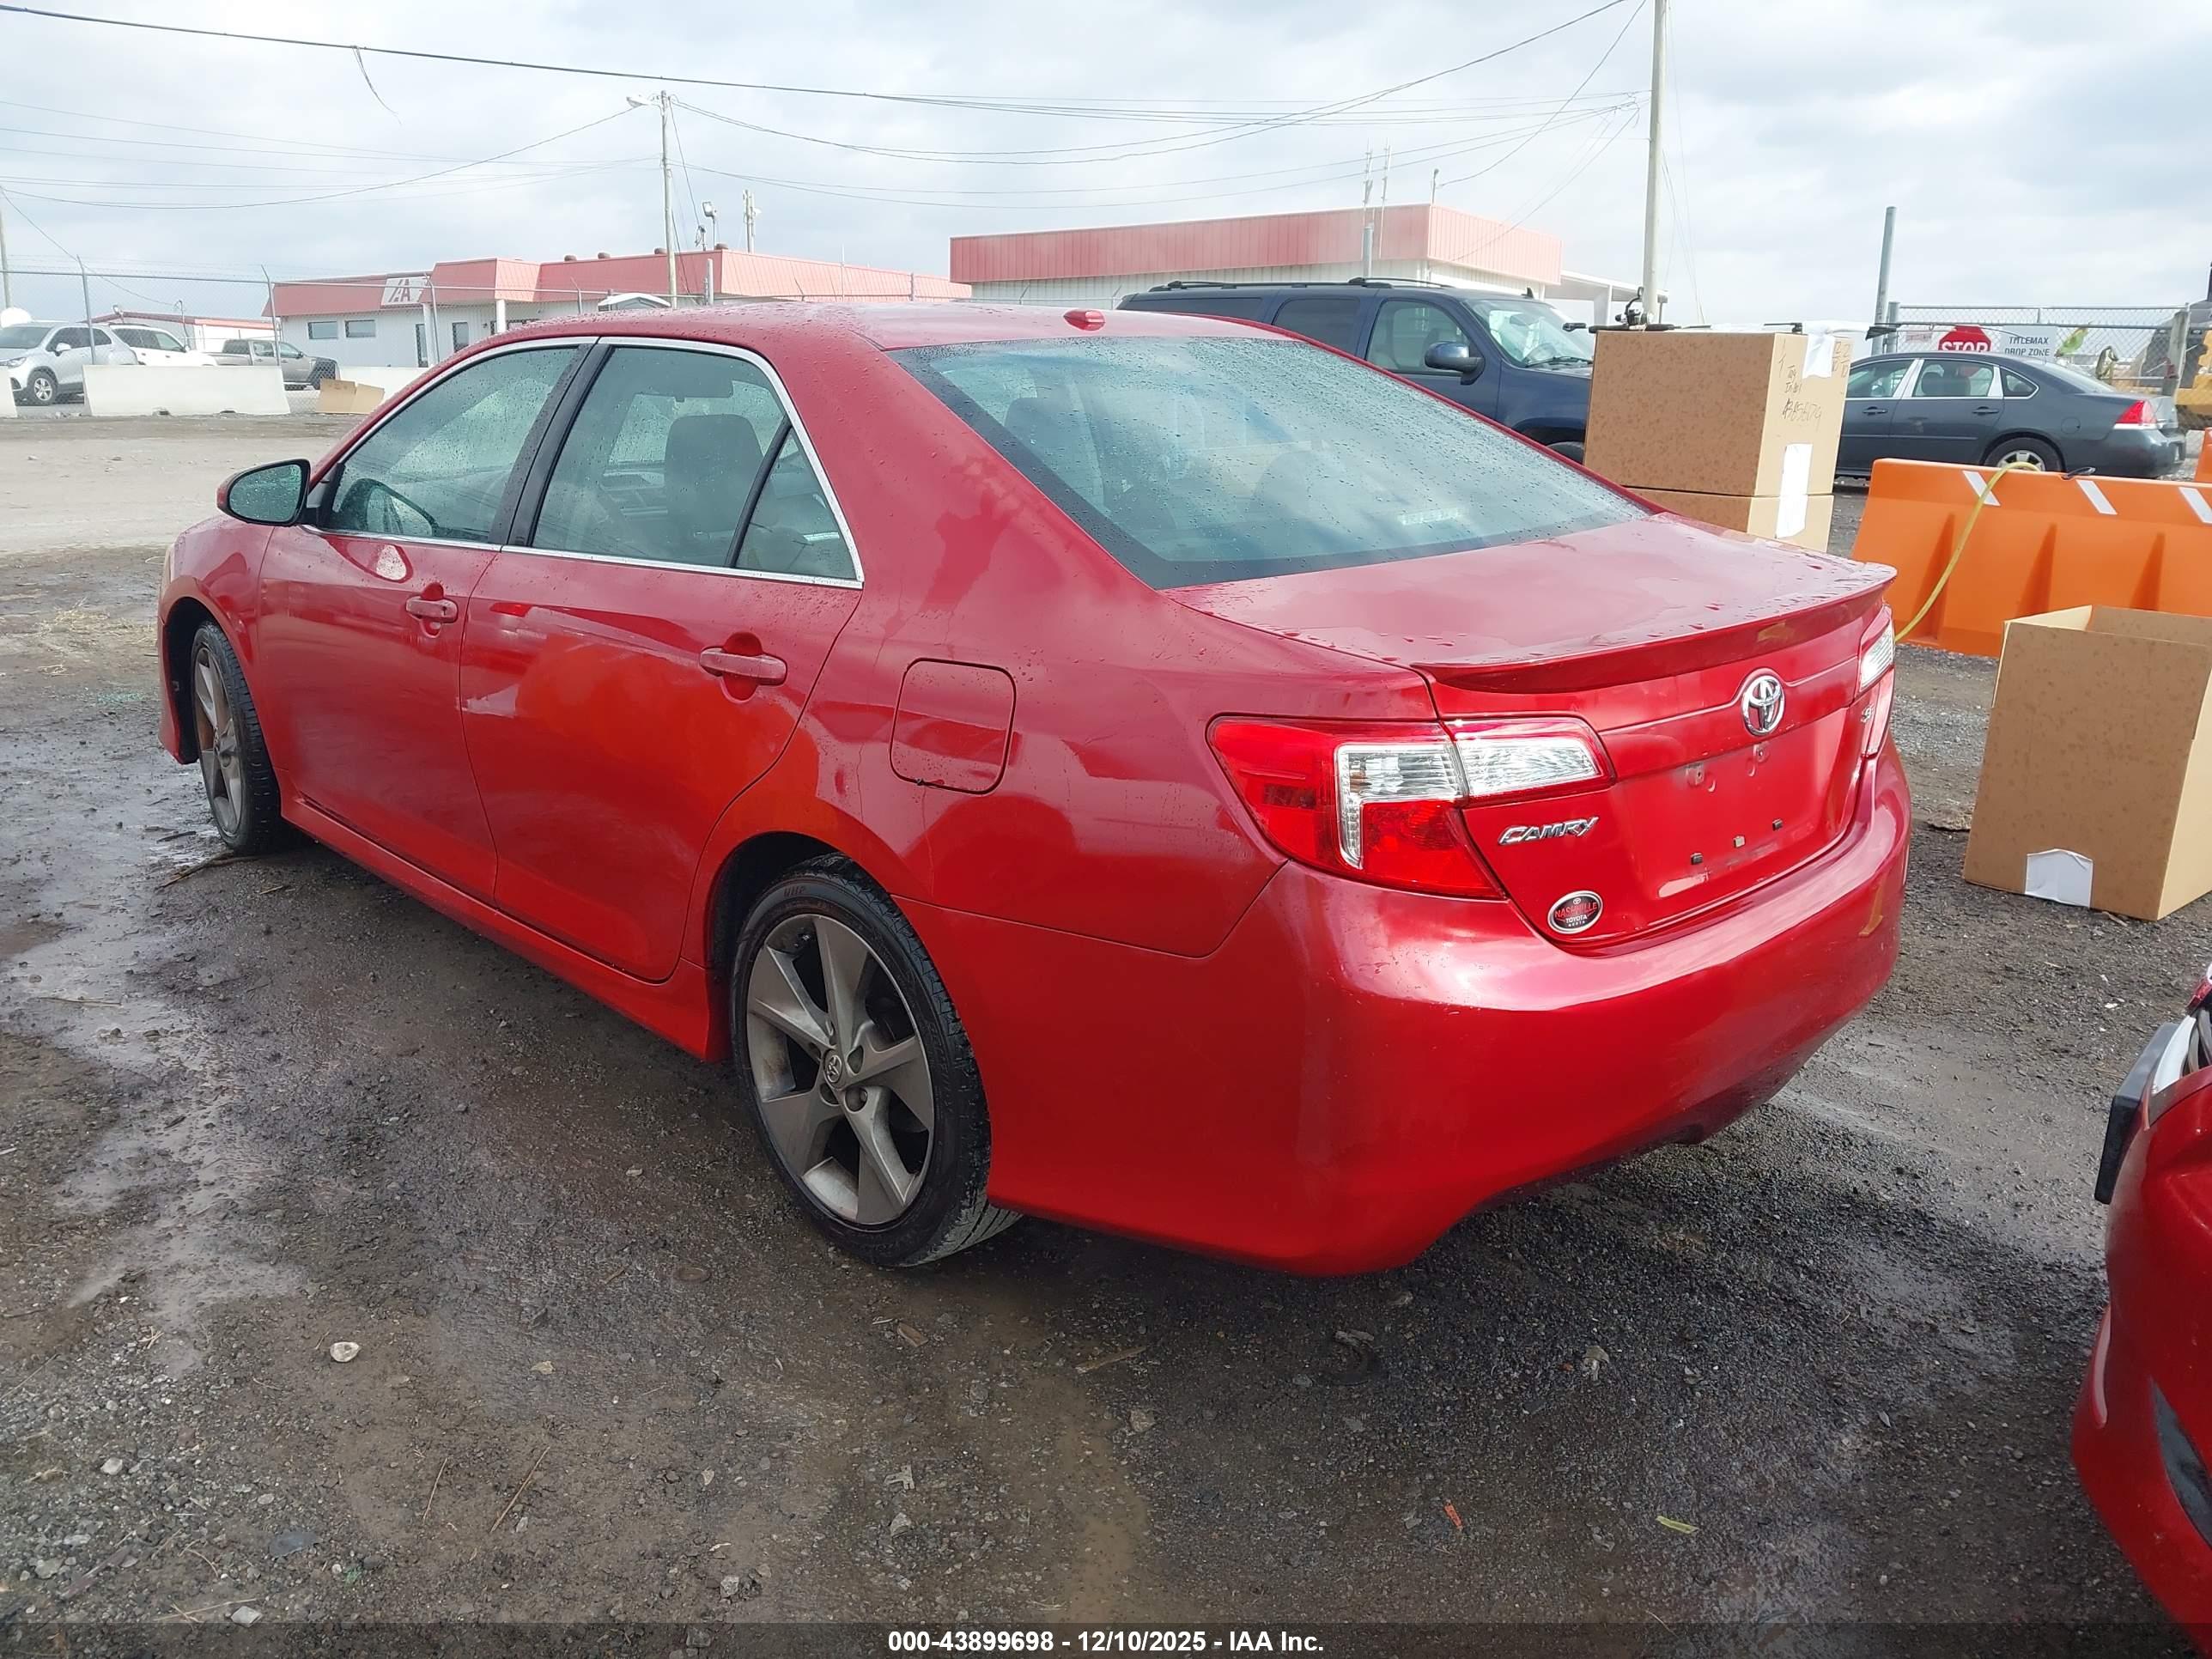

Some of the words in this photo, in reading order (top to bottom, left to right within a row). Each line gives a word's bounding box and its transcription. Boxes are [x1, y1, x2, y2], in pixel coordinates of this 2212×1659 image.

[2009, 336, 2049, 344] TITLEMAX
[2027, 348, 2050, 356] ZONE
[1498, 816, 1599, 845] CAMRY
[1554, 902, 1598, 918] NASHVILLE
[1565, 914, 1588, 924] TOYOTA
